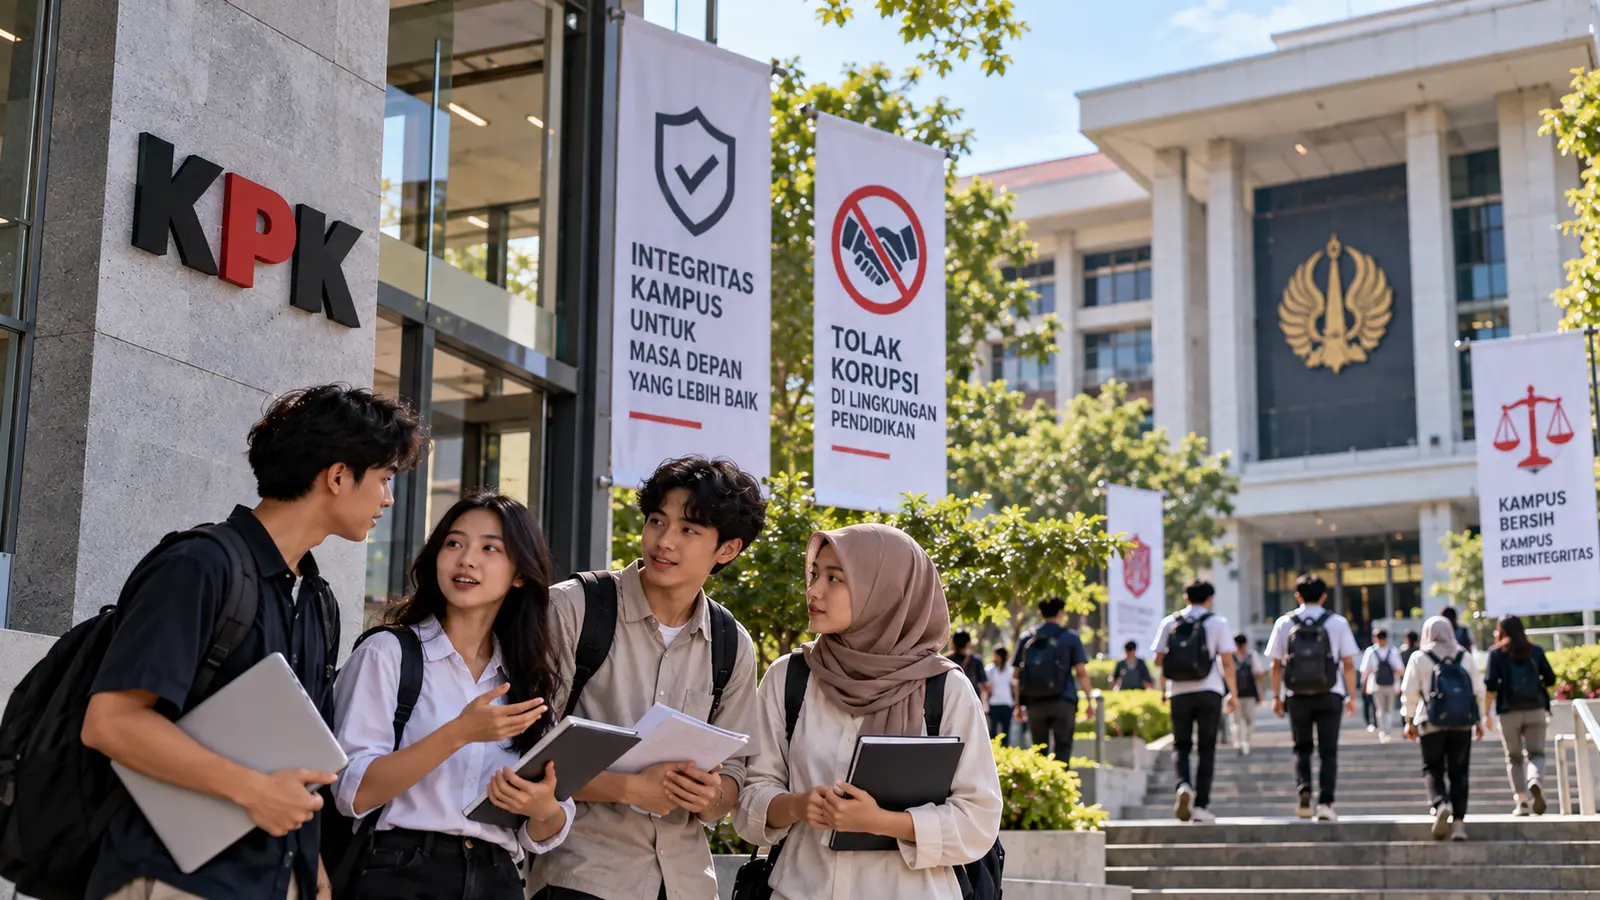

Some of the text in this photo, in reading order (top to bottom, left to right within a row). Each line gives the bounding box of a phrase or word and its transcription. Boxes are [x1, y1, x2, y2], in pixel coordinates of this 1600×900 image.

[131, 131, 363, 328] KPK
[631, 241, 754, 295] INTEGRITAS
[630, 274, 723, 319] KAMPUS
[630, 308, 696, 343] UNTUK
[831, 324, 902, 362] TOLAK
[629, 339, 742, 380] MASA DEPAN
[831, 356, 918, 395] KORUPSI
[628, 370, 758, 411] YANG LEBIH BAIK
[831, 387, 937, 422] DI LINGKUNGAN
[831, 409, 915, 440] PENDIDIKAN
[1499, 490, 1567, 513] KAMPUS
[1500, 511, 1554, 531] BERSIH
[1500, 533, 1553, 551] KAMPUS
[1501, 547, 1594, 568] BERINTEGRITAS
